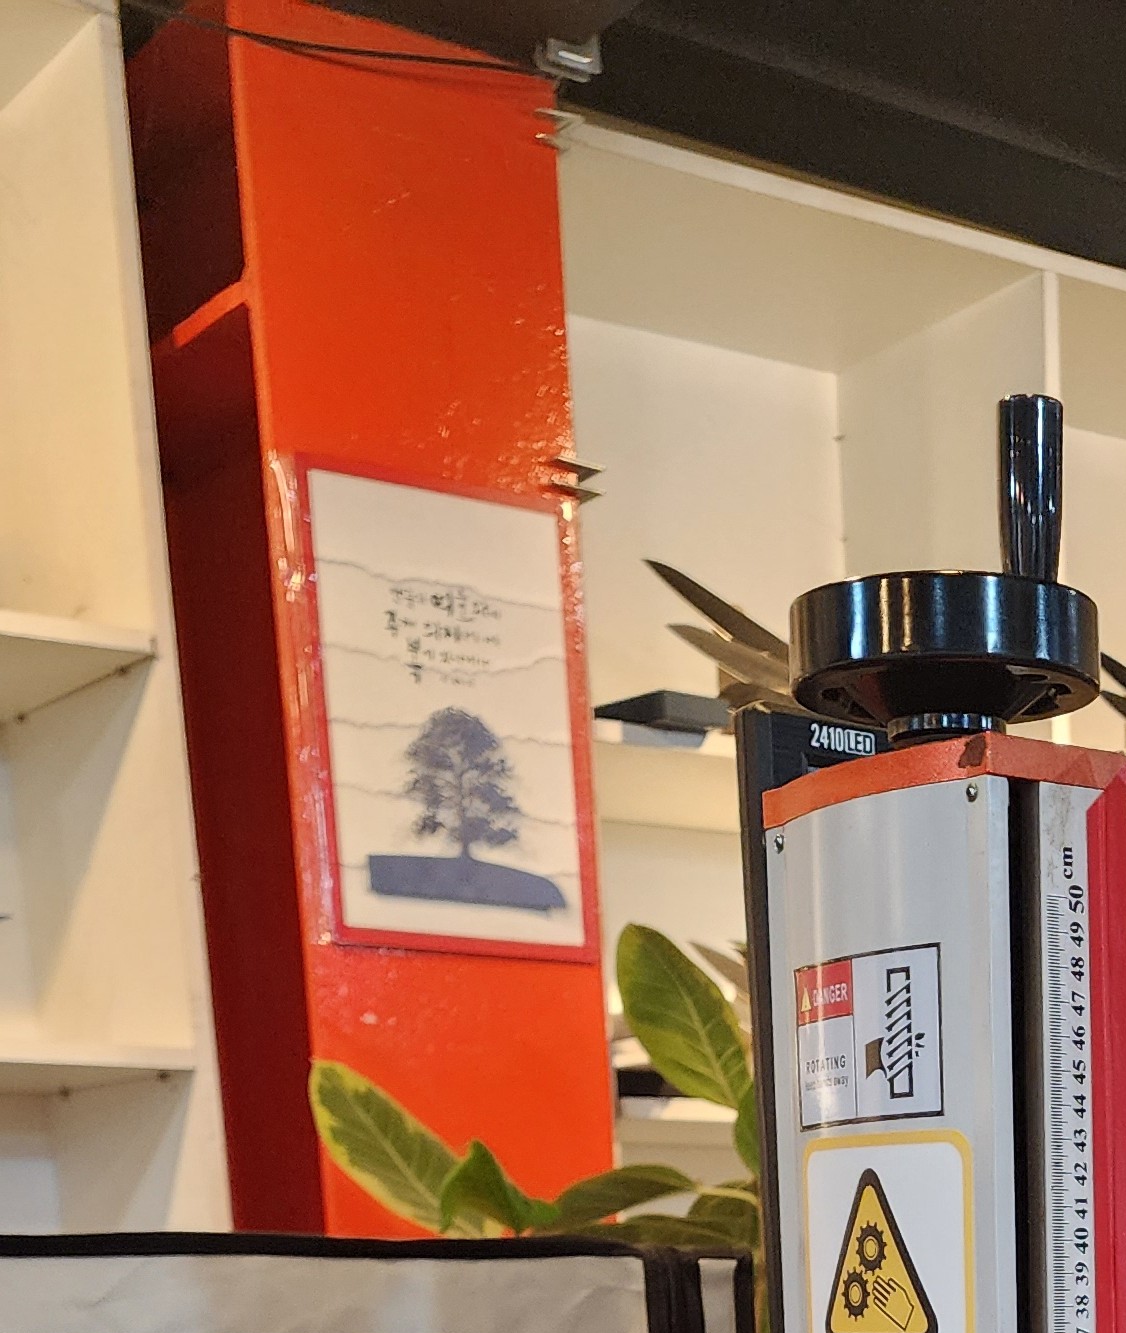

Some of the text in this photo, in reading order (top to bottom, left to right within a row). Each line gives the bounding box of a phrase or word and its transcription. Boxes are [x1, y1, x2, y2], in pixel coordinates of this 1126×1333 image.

[810, 722, 844, 752] 2410
[1062, 846, 1073, 880] cm
[1068, 885, 1084, 913] 50
[1069, 922, 1083, 947] 49
[1071, 957, 1084, 981] 48
[813, 983, 848, 1006] DANGER
[1070, 991, 1084, 1016] 47
[1071, 1026, 1085, 1050] 46
[806, 1055, 846, 1073] ROTATING
[1071, 1060, 1085, 1084] 45
[1073, 1094, 1086, 1118] 44
[1072, 1129, 1086, 1152] 43
[1074, 1163, 1087, 1186] 42
[1075, 1199, 1087, 1219] 41
[1074, 1228, 1088, 1254] 40
[1074, 1262, 1088, 1285] 39
[1074, 1295, 1088, 1317] 38
